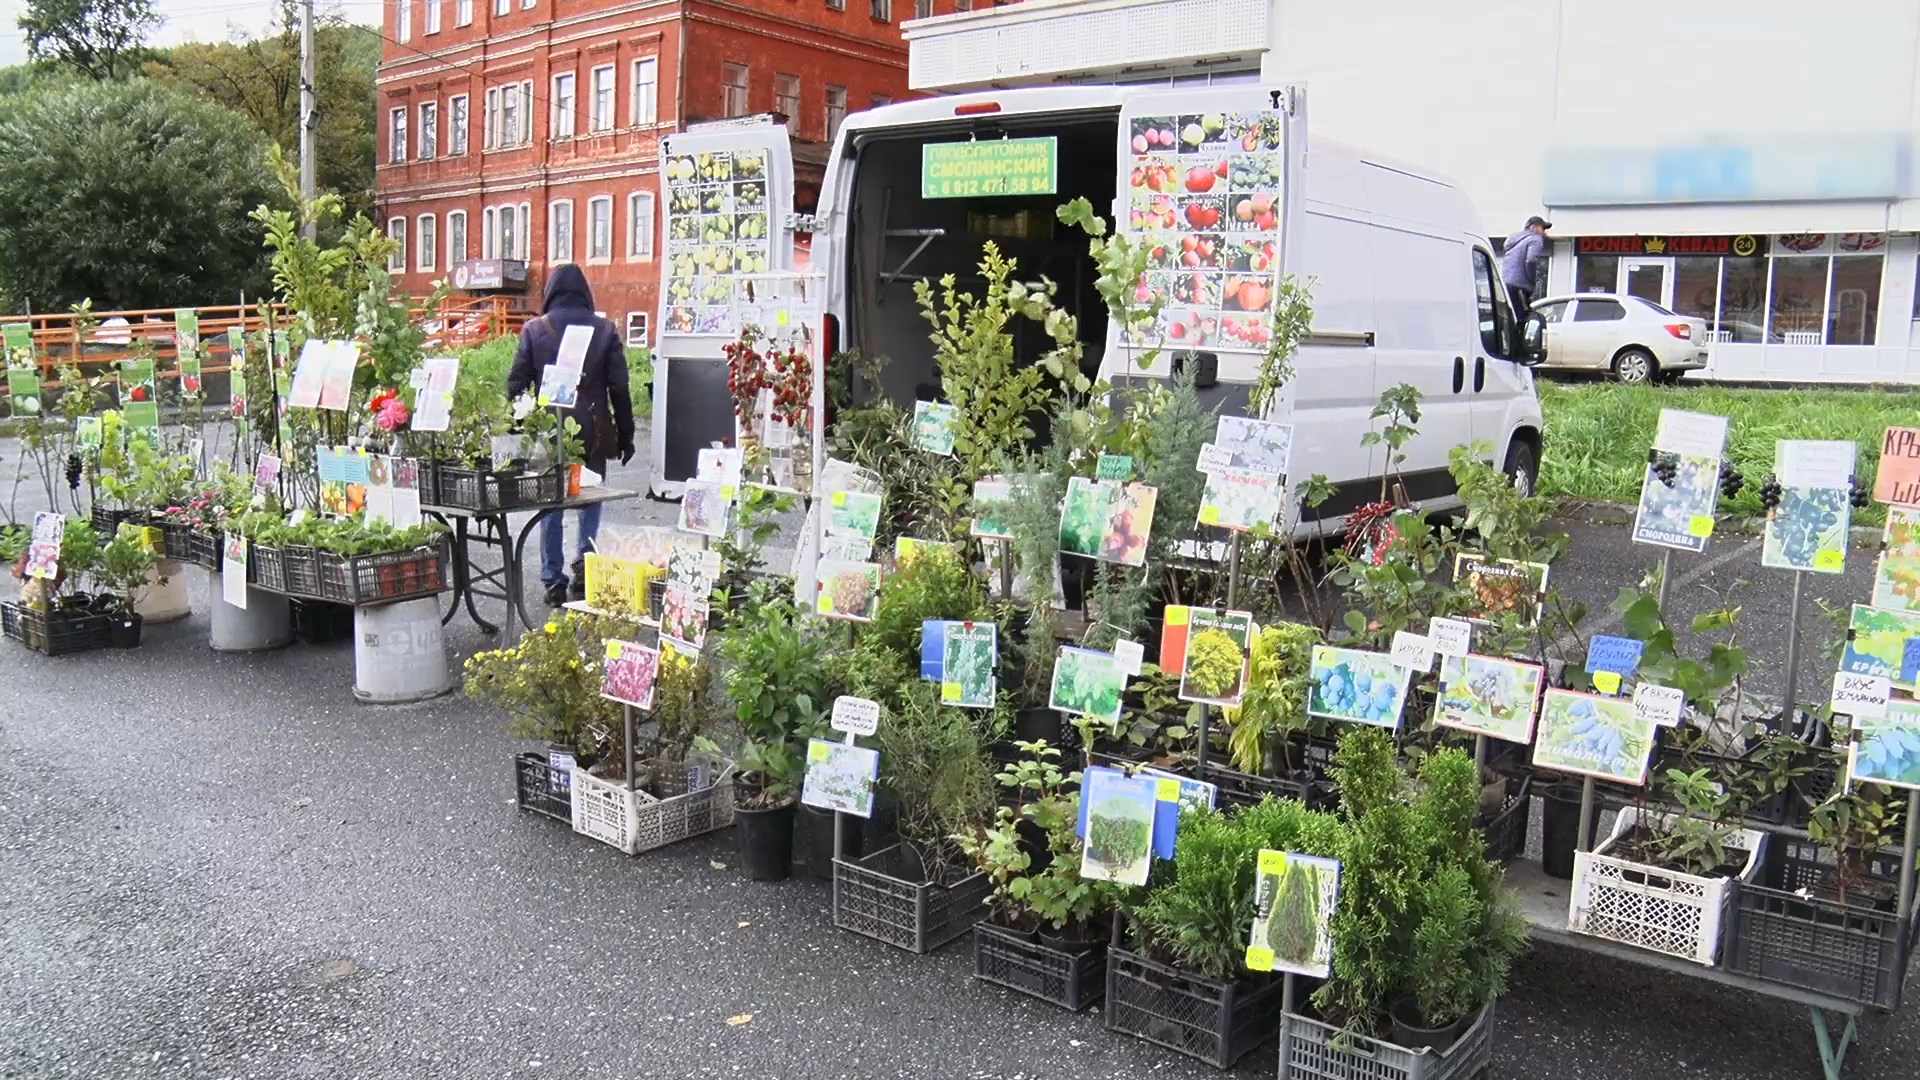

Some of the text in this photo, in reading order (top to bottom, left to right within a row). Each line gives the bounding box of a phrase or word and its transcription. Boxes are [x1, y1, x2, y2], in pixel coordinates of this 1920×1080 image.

[930, 157, 1049, 177] СМОЛИНСКИЙ
[1580, 237, 1643, 252] DONER
[1669, 236, 1729, 252] KEBAB
[1638, 528, 1694, 546] СМОРОДИНА
